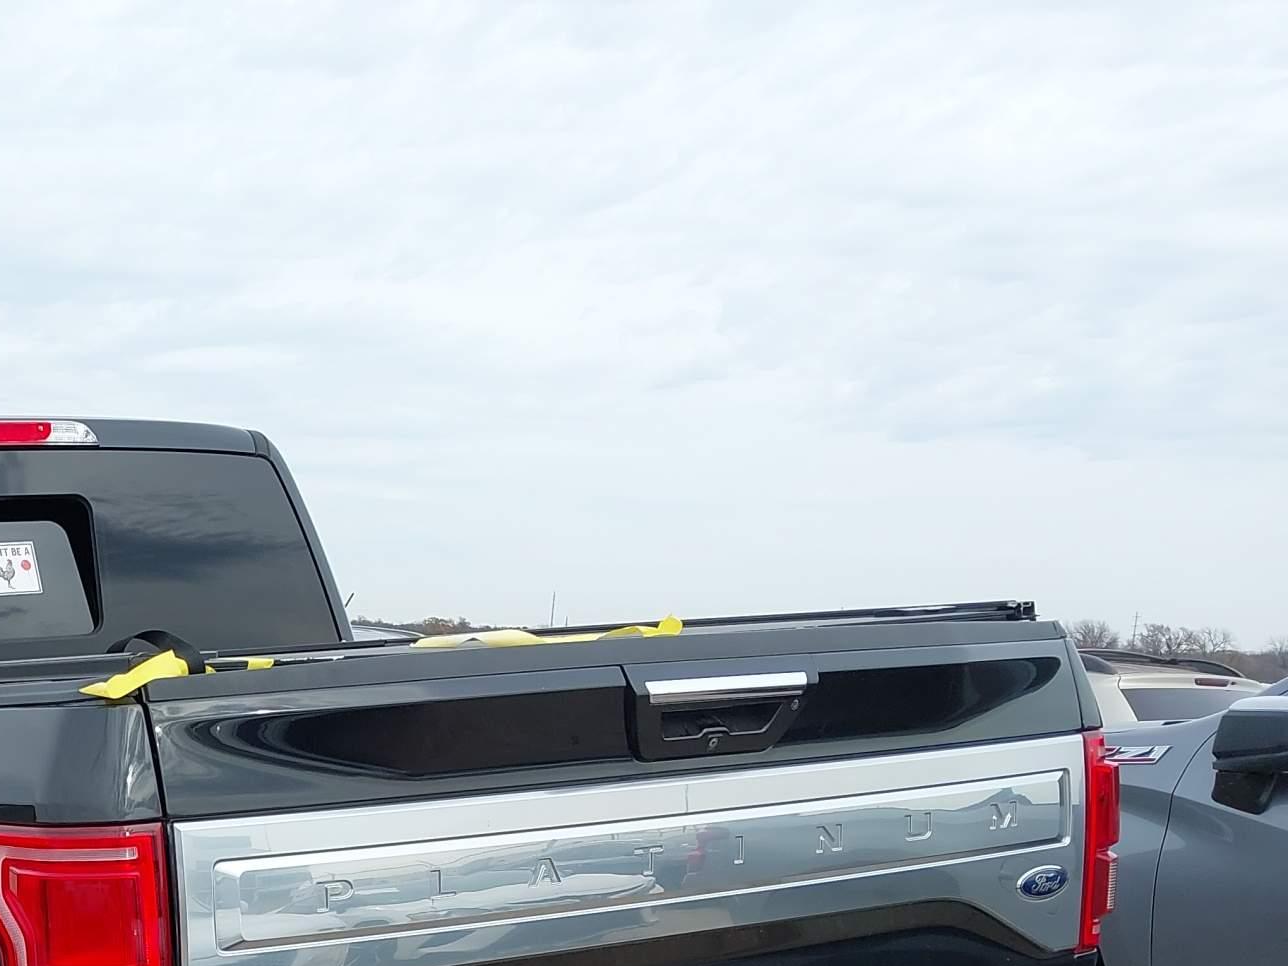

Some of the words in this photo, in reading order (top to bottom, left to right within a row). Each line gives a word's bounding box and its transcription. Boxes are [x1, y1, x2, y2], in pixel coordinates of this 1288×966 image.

[11, 547, 22, 556] BE
[24, 546, 30, 556] A
[316, 800, 1018, 913] PLATINUM
